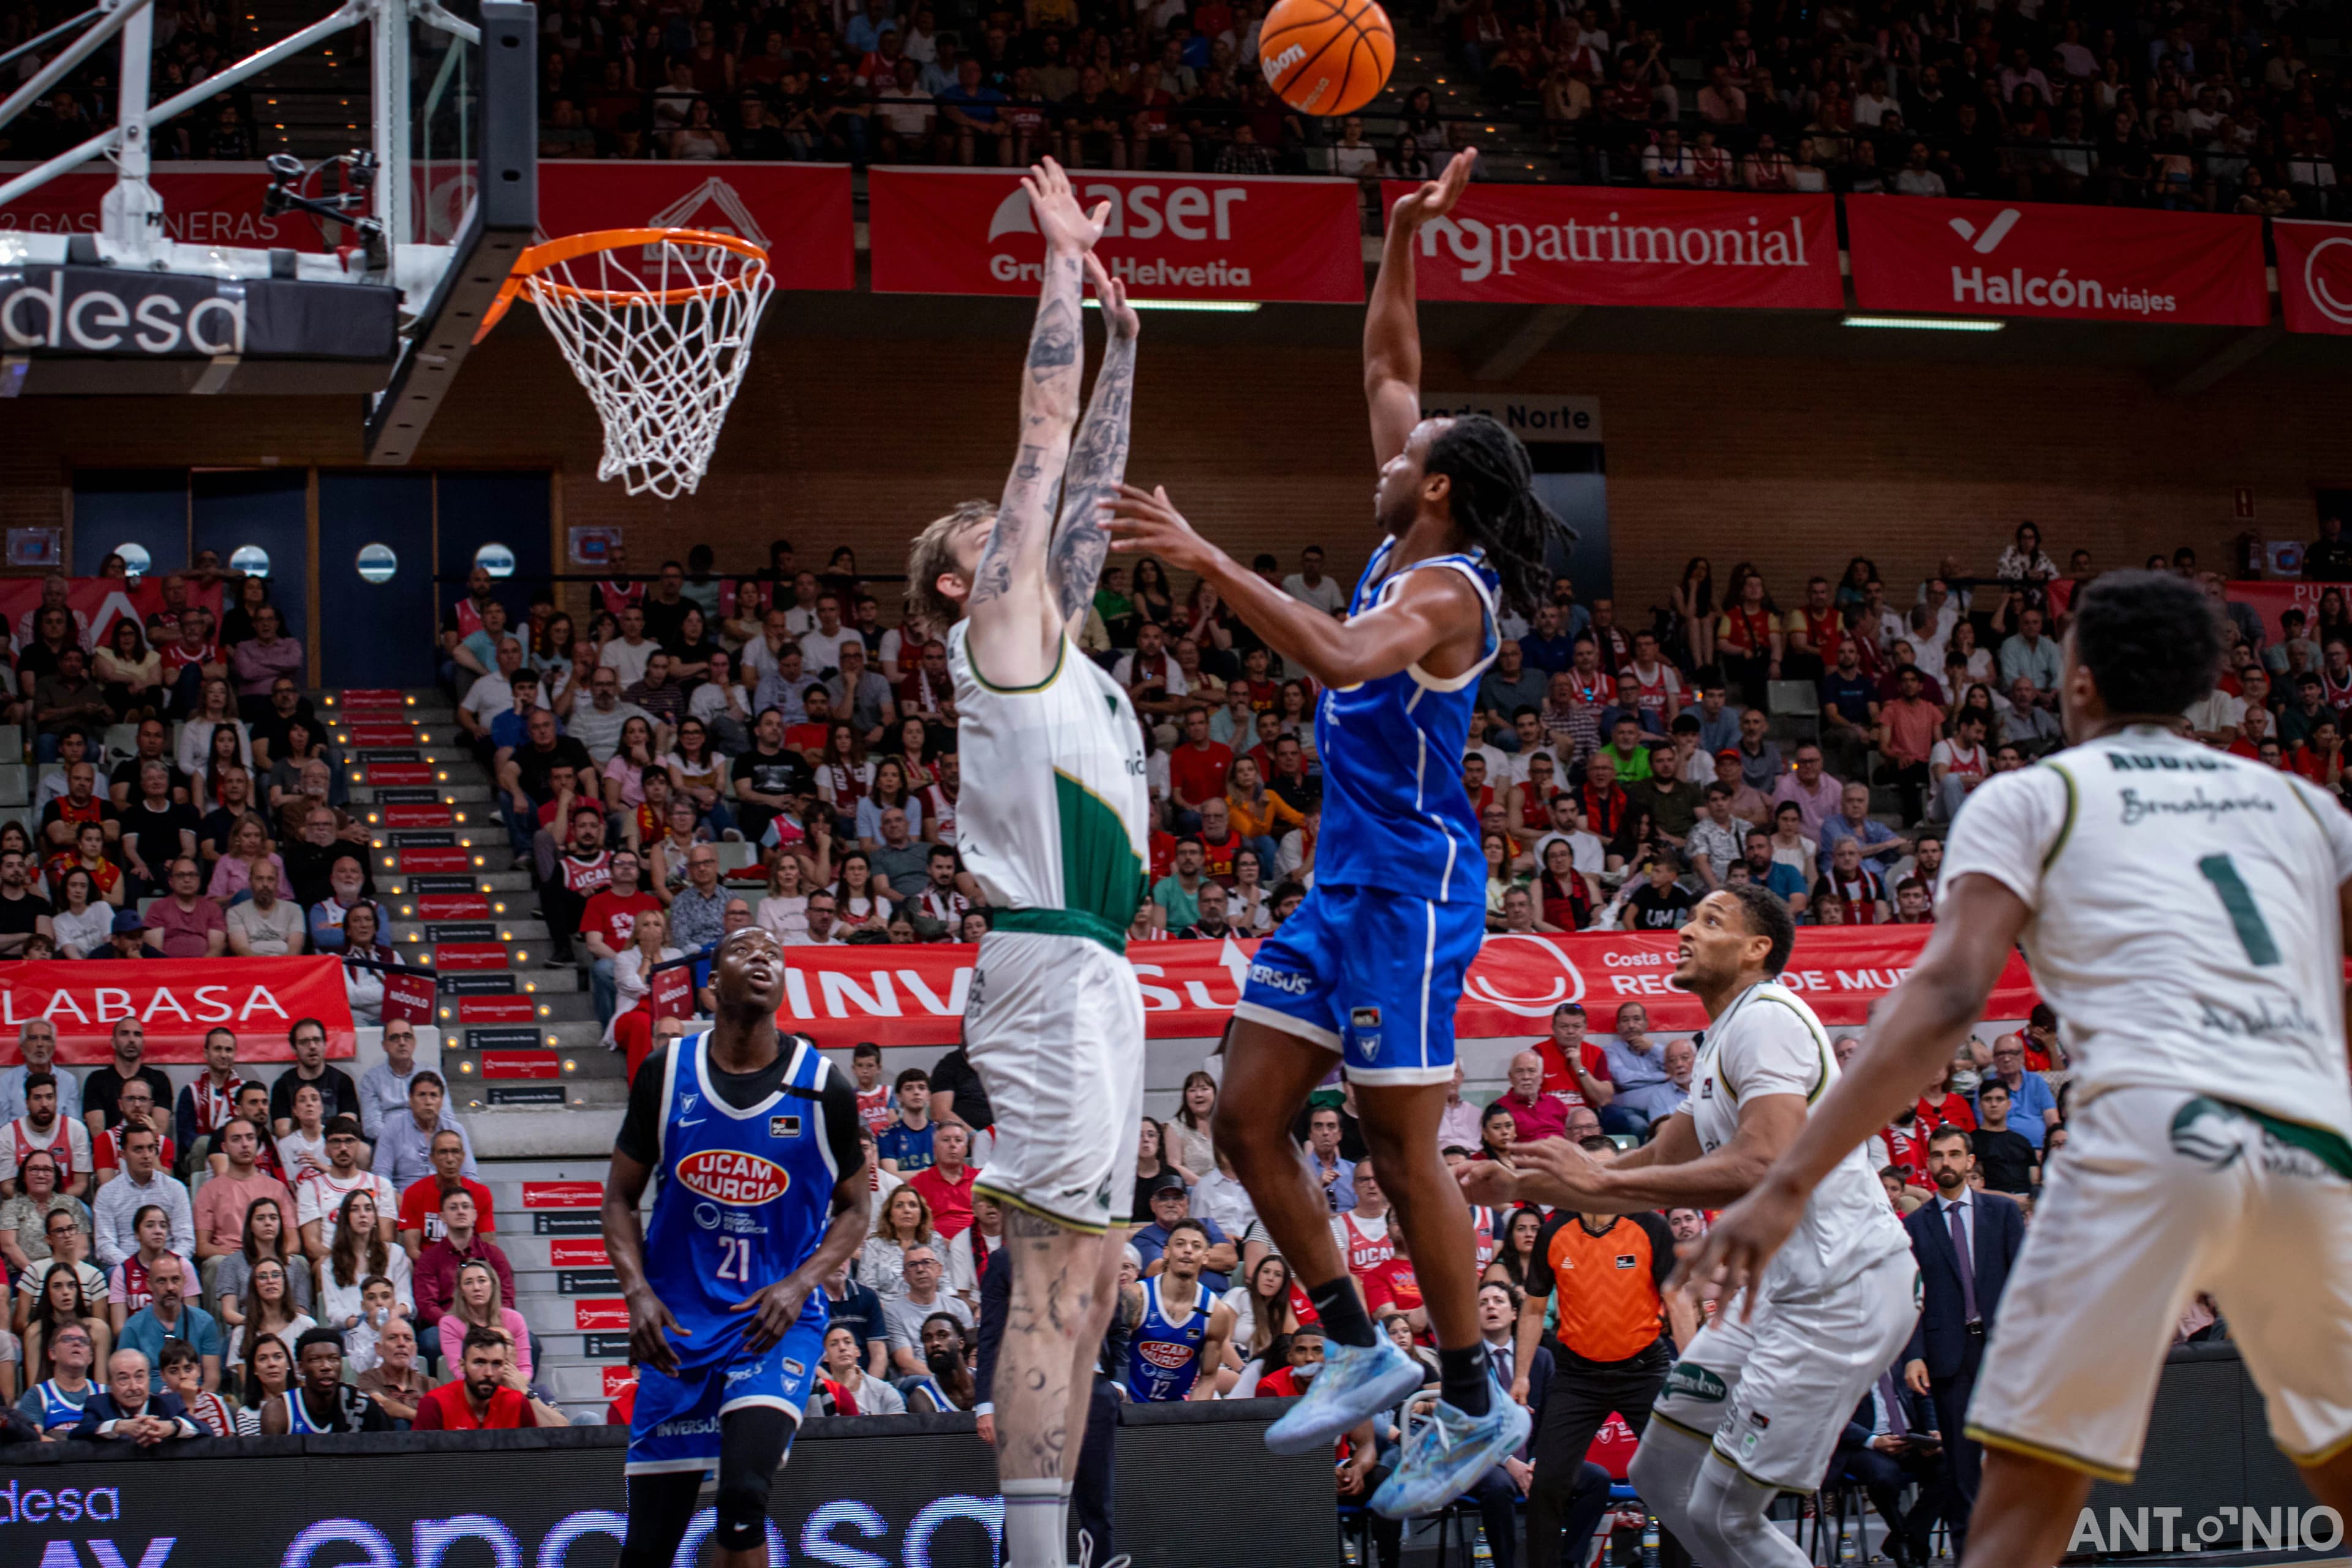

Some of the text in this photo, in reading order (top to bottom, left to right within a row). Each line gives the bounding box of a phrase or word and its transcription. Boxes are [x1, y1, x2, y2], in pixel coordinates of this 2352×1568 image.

[1069, 183, 1248, 241] aser
[1494, 211, 1809, 276] patrimonial
[1111, 256, 1251, 287] Helvetia
[1951, 266, 2177, 315] Halcón viajes
[1507, 405, 1590, 429] Norte
[2198, 851, 2282, 967] 1
[1602, 951, 1662, 967] Costa
[1777, 970, 1831, 992] DE
[404, 1008, 412, 1019] 7
[698, 1154, 772, 1181] UCAM
[687, 1172, 780, 1200] MURCIA
[716, 1235, 750, 1283] 21
[1150, 1344, 1188, 1356] UCAM
[1148, 1379, 1171, 1400] 12
